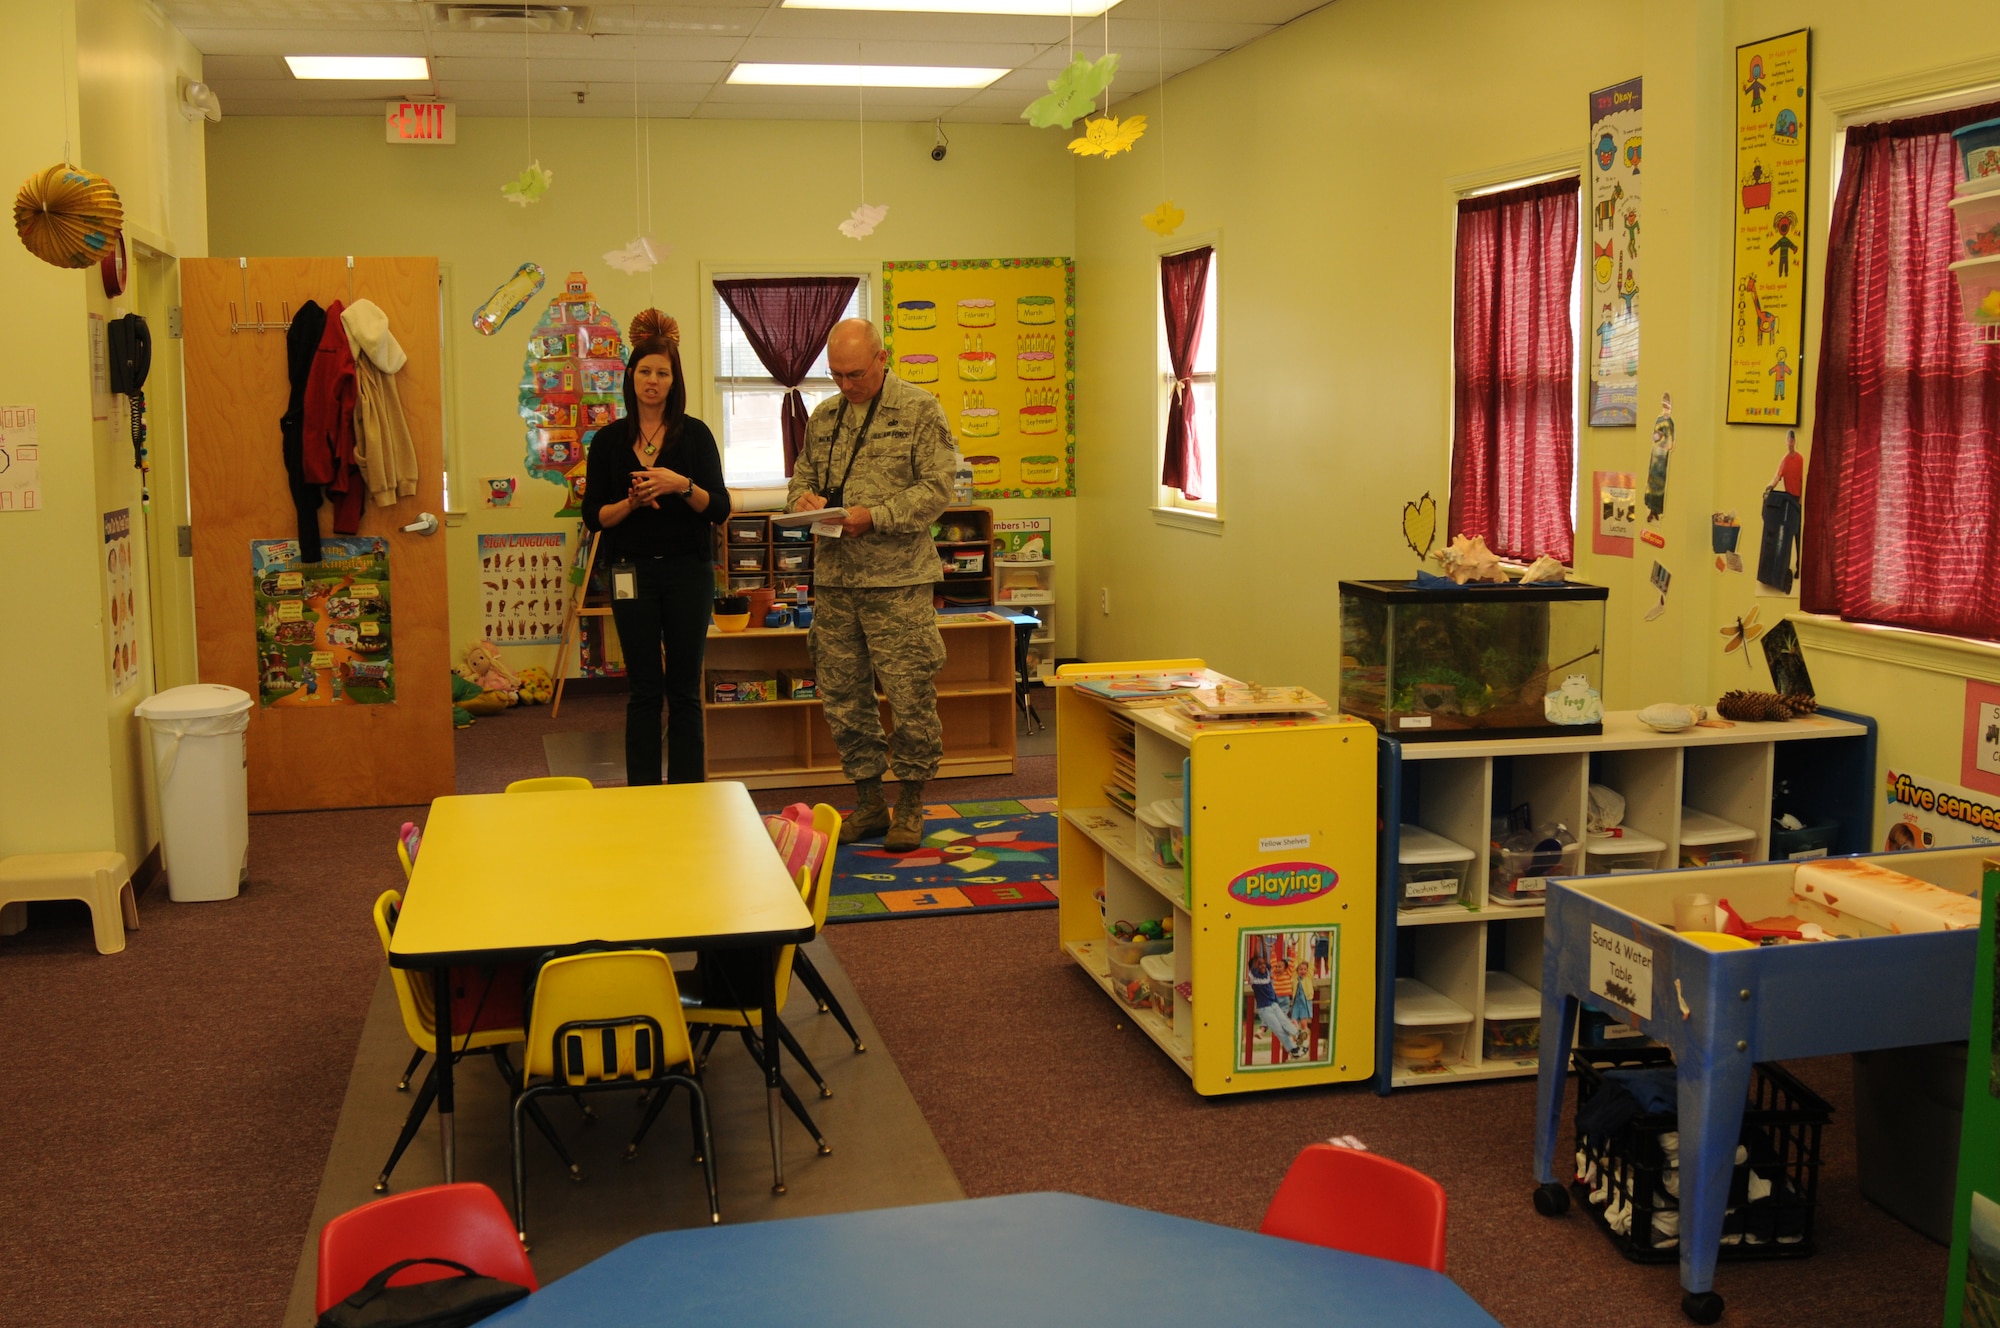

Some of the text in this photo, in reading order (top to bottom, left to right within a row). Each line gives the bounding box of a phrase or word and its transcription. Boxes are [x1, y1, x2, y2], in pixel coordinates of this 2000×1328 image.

[400, 104, 446, 139] EXIT
[903, 313, 928, 322] January
[964, 310, 990, 319] February
[967, 365, 984, 374] May
[1026, 364, 1041, 373] June
[994, 522, 1020, 530] mbers
[484, 535, 561, 548] SIGN LANGUAGE
[1013, 535, 1020, 545] 6
[1895, 774, 2000, 833] five senses
[1903, 812, 1918, 823] sight
[1244, 870, 1322, 897] Playing
[1592, 931, 1651, 968] Sand & Water
[1609, 961, 1632, 984] Table
